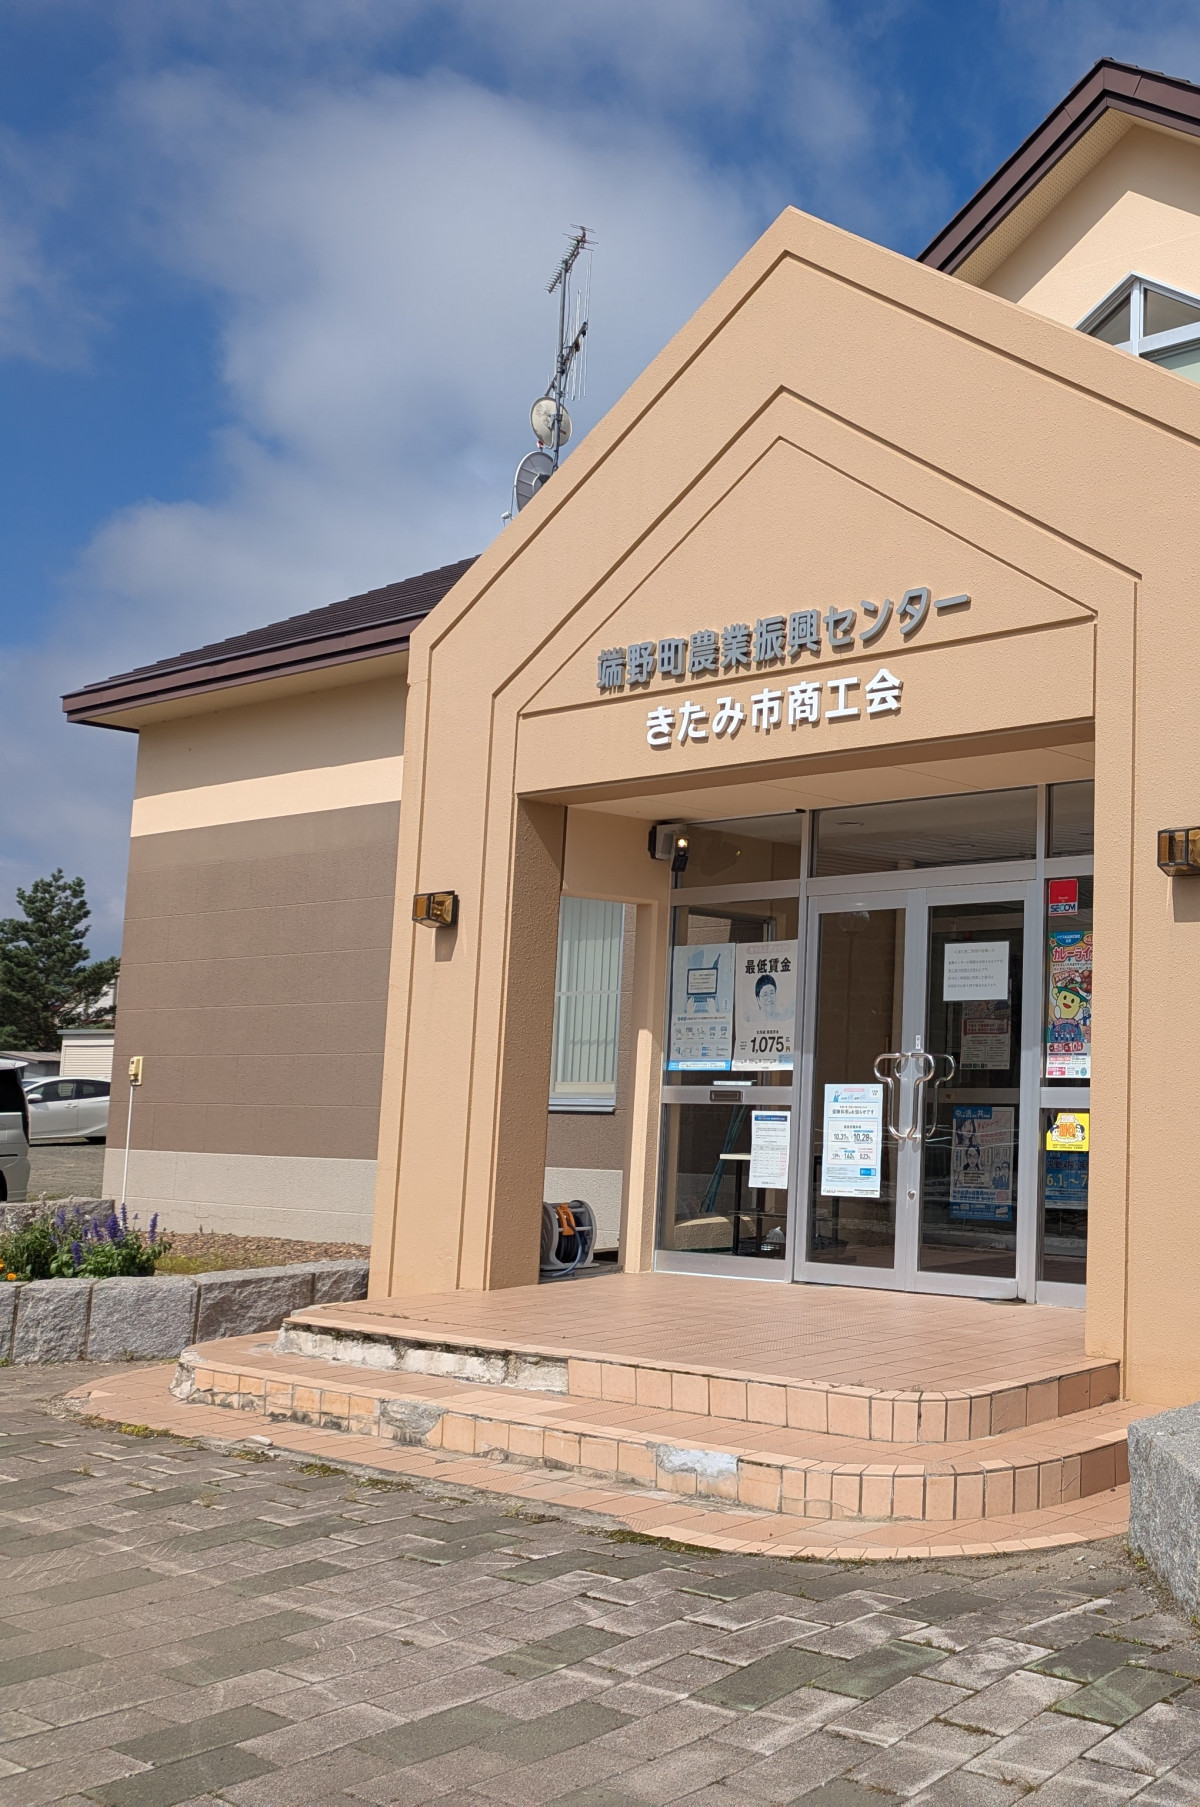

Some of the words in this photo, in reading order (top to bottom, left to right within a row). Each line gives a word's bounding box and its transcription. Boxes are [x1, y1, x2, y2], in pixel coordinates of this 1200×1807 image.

[596, 587, 971, 689] 端野町農業振興センター
[646, 668, 903, 746] きたみ市商工会
[1051, 904, 1076, 913] SECOM
[745, 957, 791, 974] 最低賃金
[750, 1036, 784, 1054] 1,075
